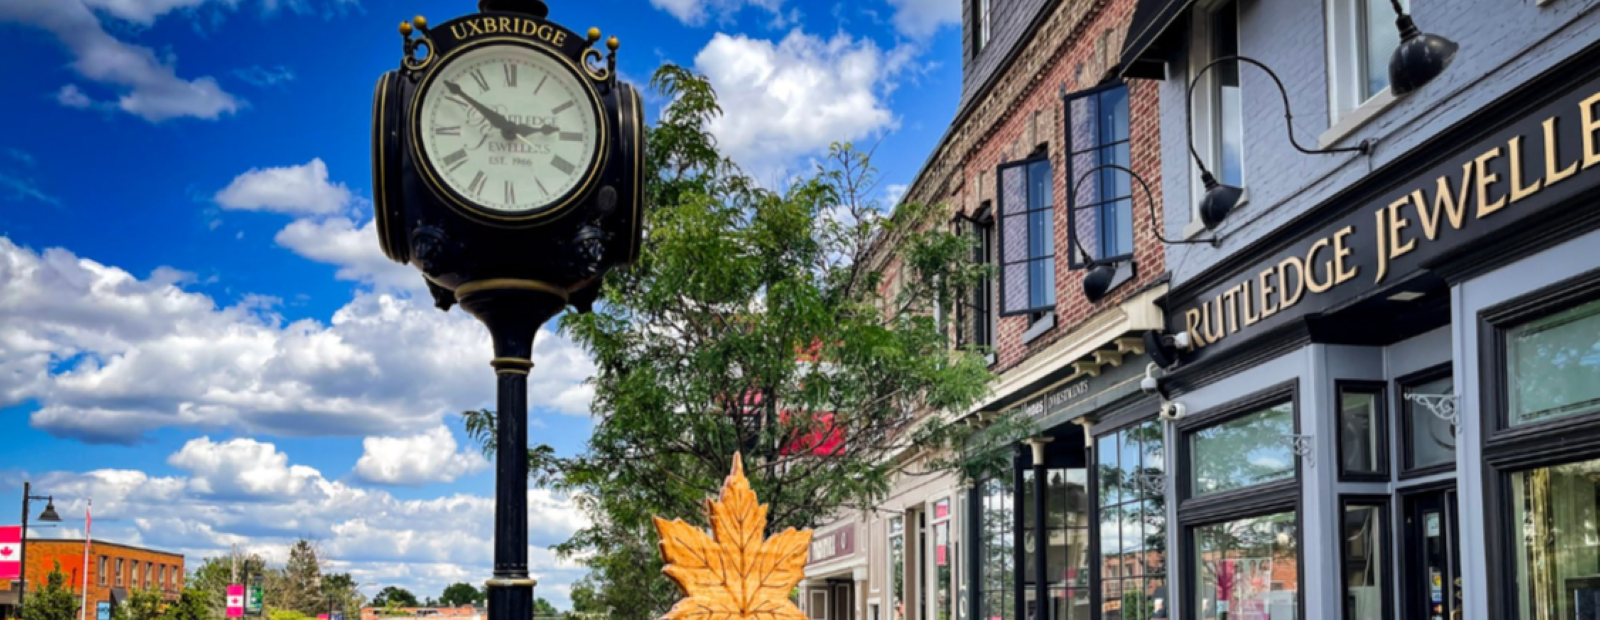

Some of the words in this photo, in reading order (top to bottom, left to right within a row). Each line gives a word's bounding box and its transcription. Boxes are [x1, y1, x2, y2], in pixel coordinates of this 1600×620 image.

[450, 16, 567, 47] UXBRIDGE
[488, 156, 508, 166] EST.
[1185, 225, 1358, 353] RUTLEDGE
[1374, 91, 1600, 284] JEWELLE
